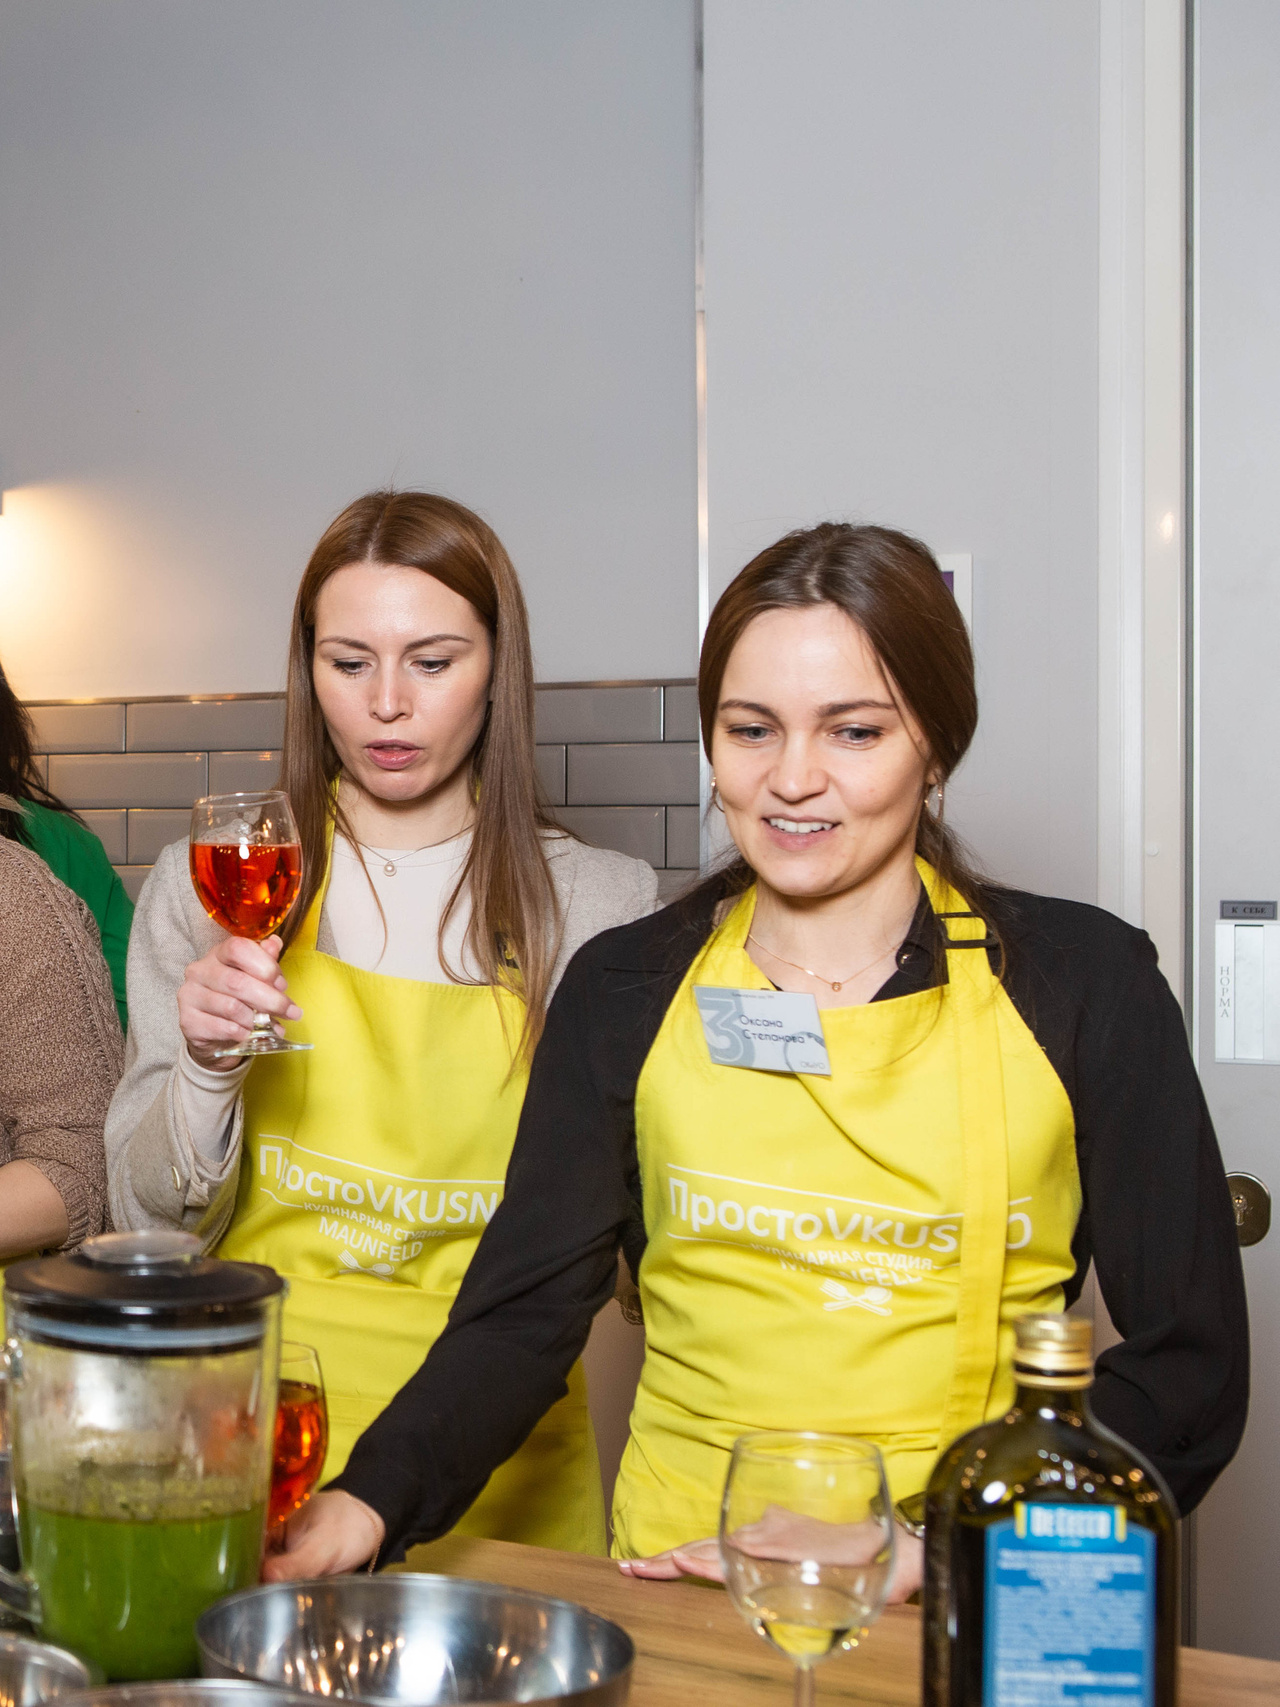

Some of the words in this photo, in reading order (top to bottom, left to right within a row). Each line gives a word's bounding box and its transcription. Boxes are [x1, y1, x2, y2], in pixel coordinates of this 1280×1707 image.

[1242, 906, 1267, 914] СЕБЕ
[1219, 966, 1231, 1018] НОРМА
[739, 1014, 784, 1028] Оксана
[742, 1029, 805, 1044] Степанова
[259, 1145, 497, 1224] ПостоVKUSN
[304, 1202, 391, 1236] КУЛИНАРНАЯ
[668, 1177, 1032, 1253] ПростоVKUSO
[319, 1216, 423, 1262] MAUNFELD
[864, 1251, 933, 1271] СТУДИЯ
